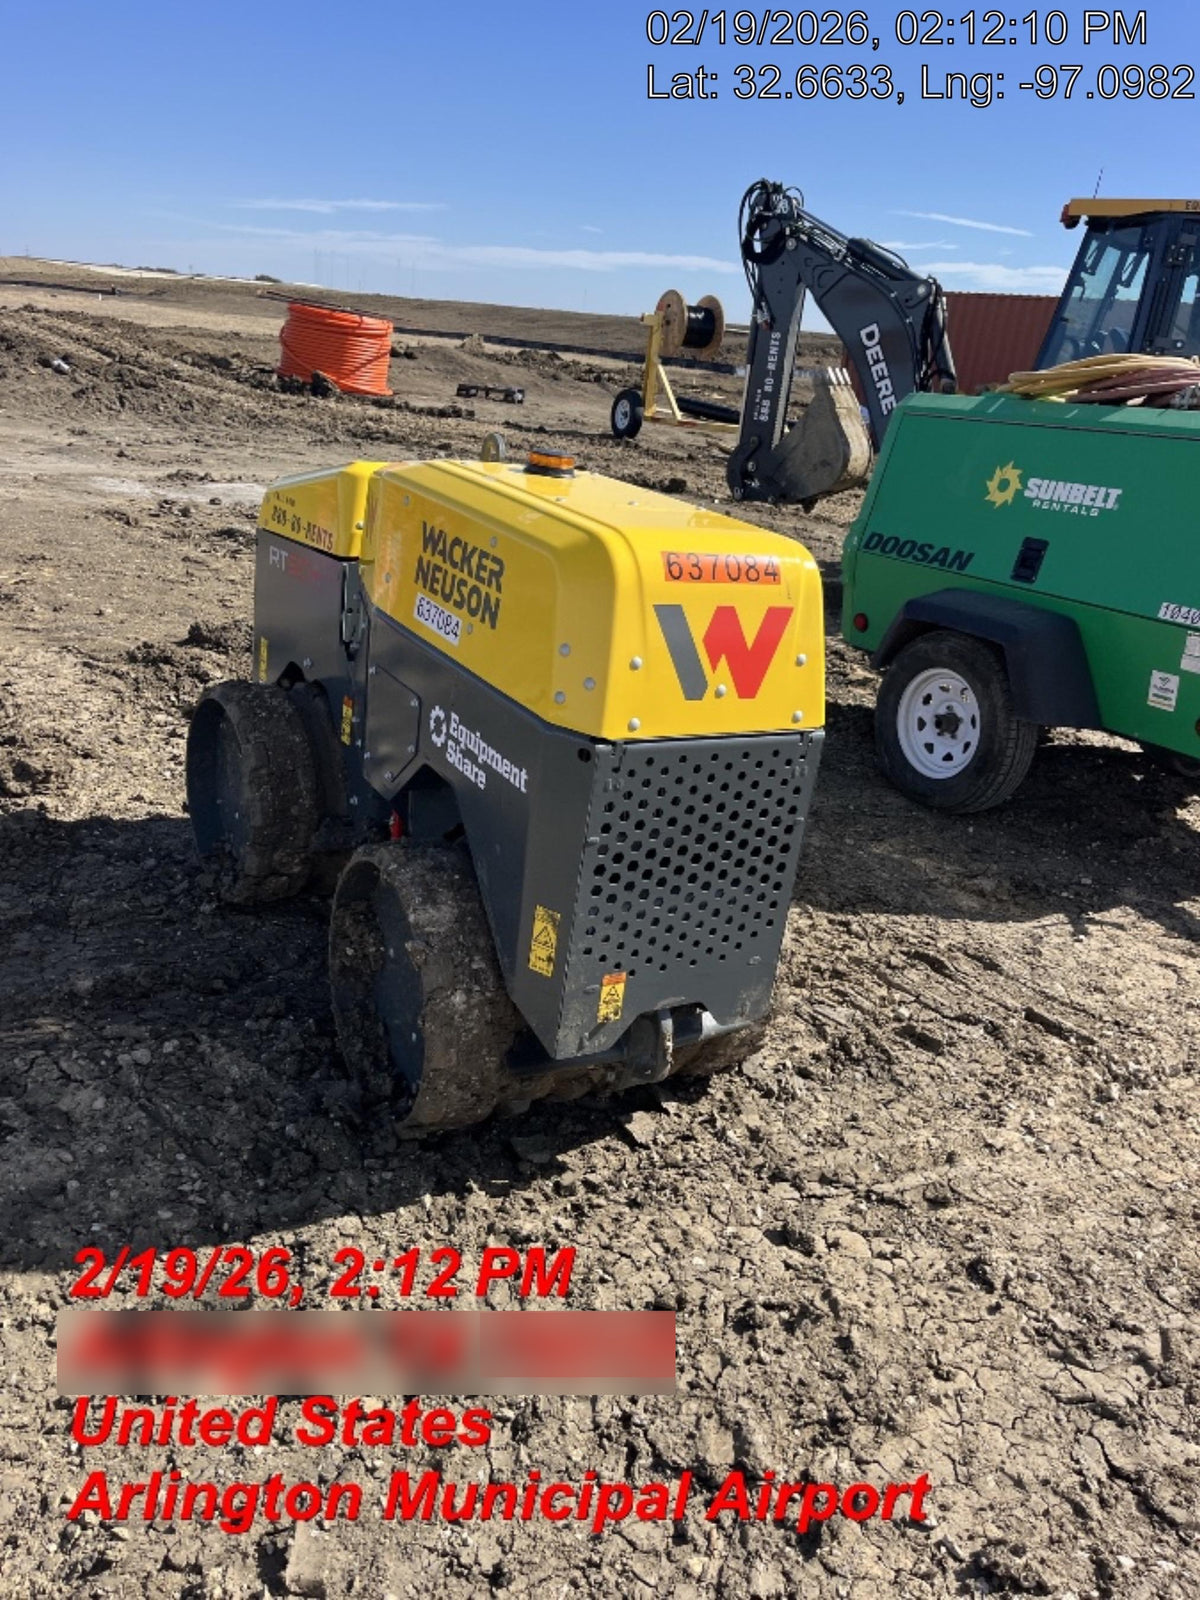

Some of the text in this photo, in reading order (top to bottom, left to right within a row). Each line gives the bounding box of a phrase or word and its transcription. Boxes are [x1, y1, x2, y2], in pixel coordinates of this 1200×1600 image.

[859, 322, 898, 416] DEERE
[1024, 478, 1122, 510] SUNBELT
[1032, 499, 1101, 517] RENTALS
[422, 520, 505, 594] WACKER
[665, 552, 779, 582] 637084
[863, 532, 976, 571] DOOSAN
[414, 554, 501, 630] NEUSON
[416, 596, 460, 638] 637084
[446, 739, 487, 790] Share
[449, 711, 529, 793] Equipment
